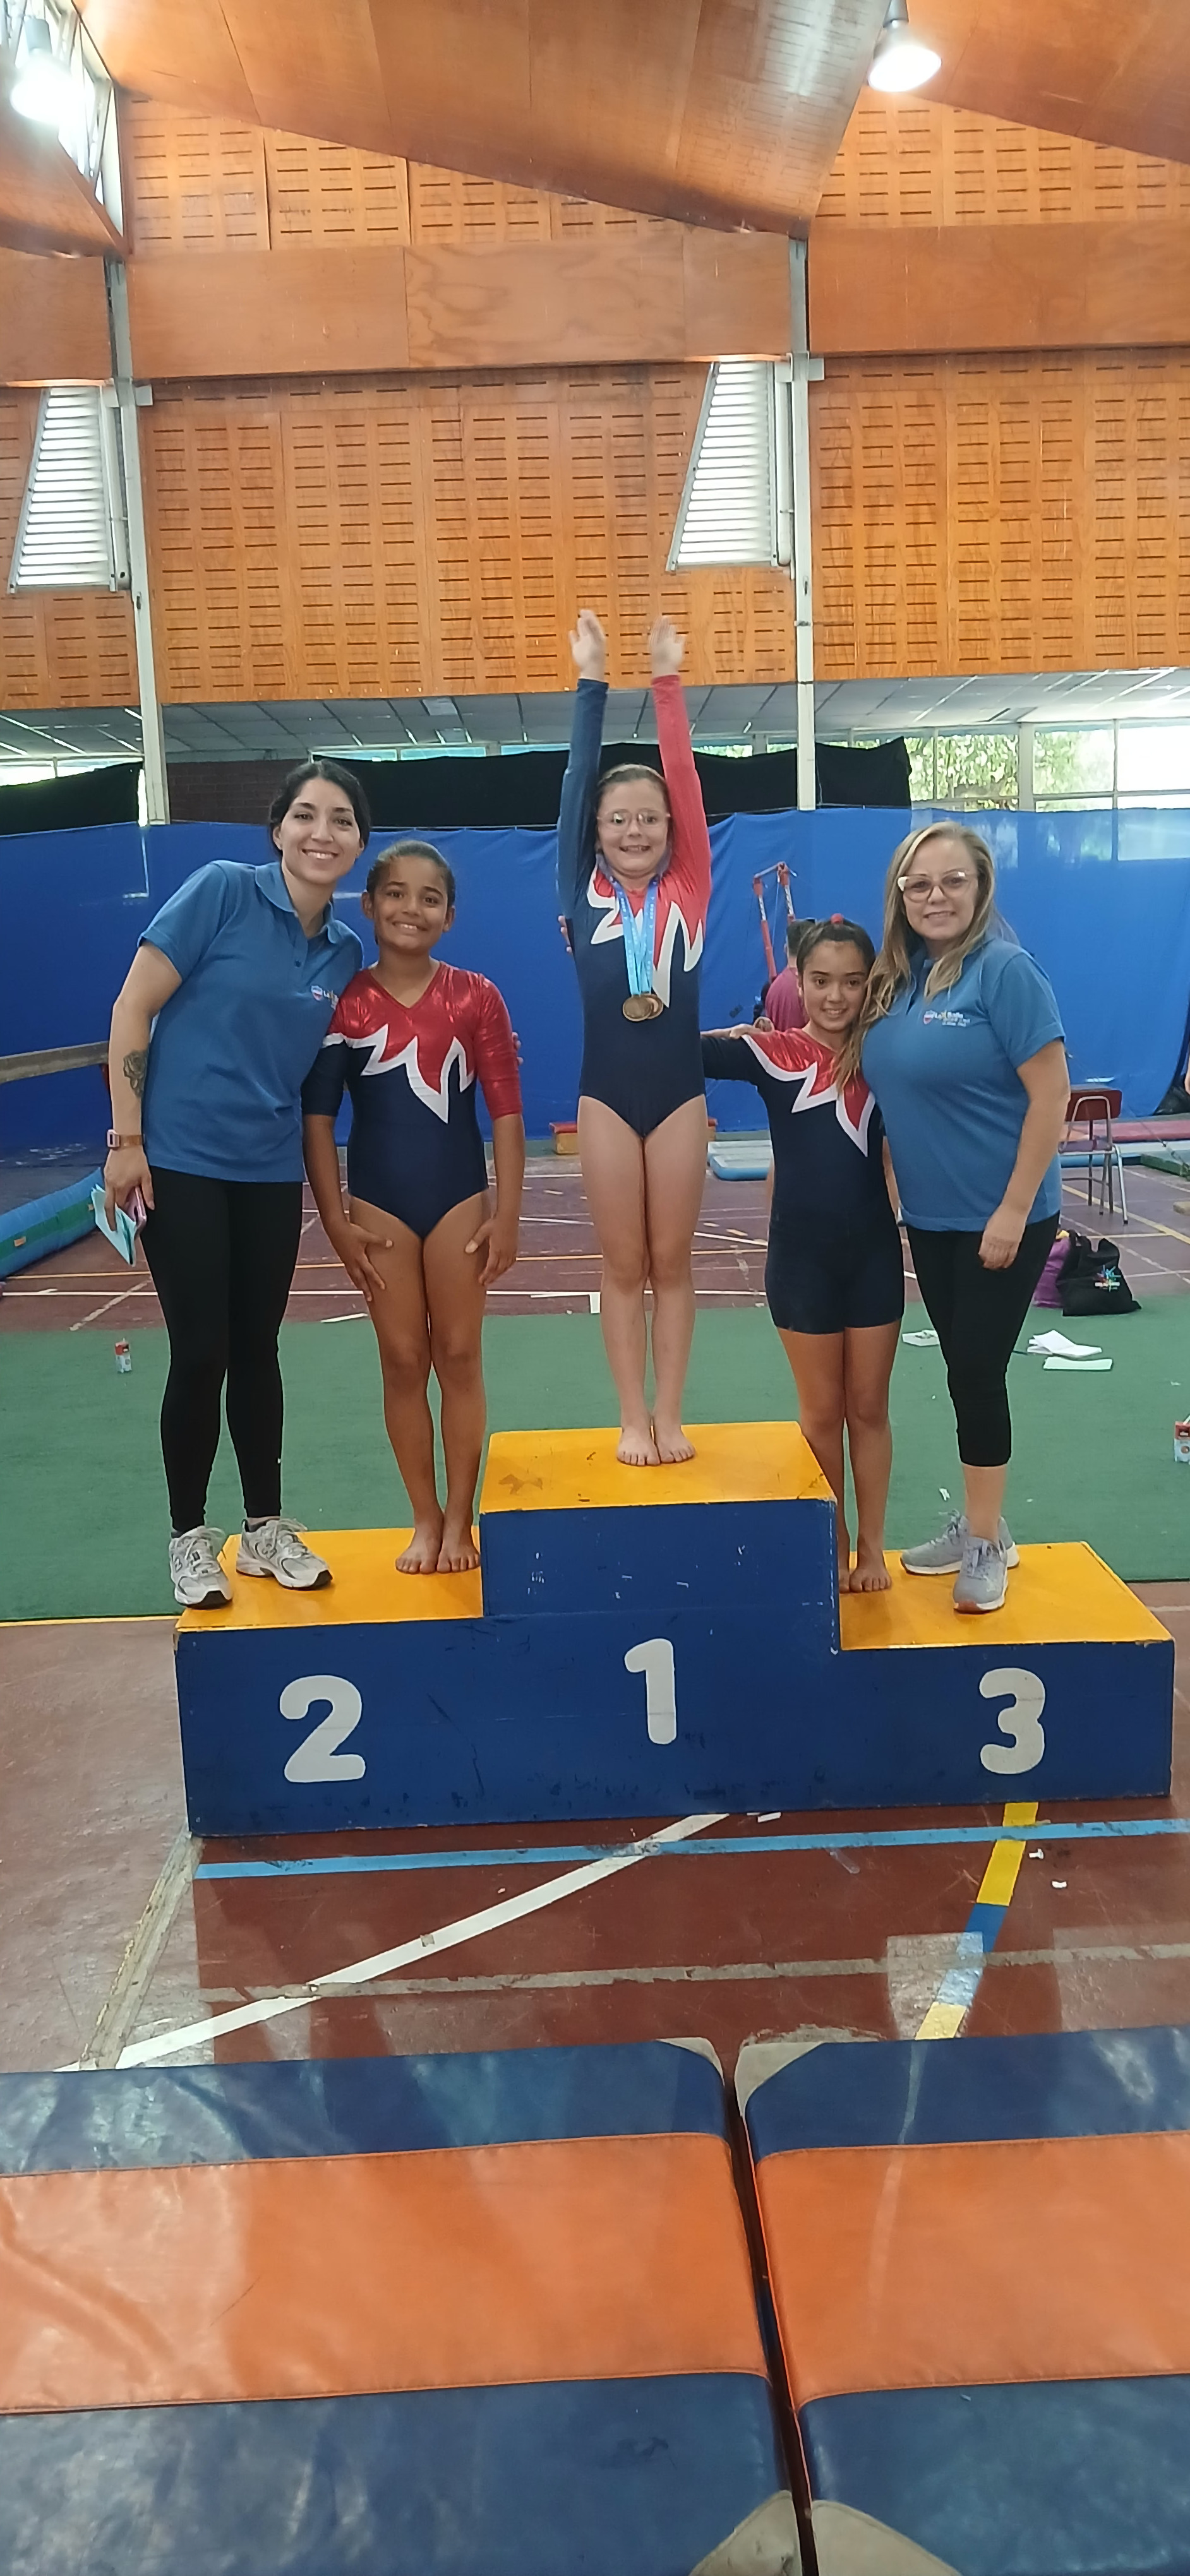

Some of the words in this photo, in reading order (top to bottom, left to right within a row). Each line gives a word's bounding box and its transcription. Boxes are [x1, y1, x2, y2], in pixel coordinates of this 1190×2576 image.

[280, 1675, 366, 1783] 2
[625, 1638, 677, 1744] 1
[980, 1668, 1046, 1774] 3
